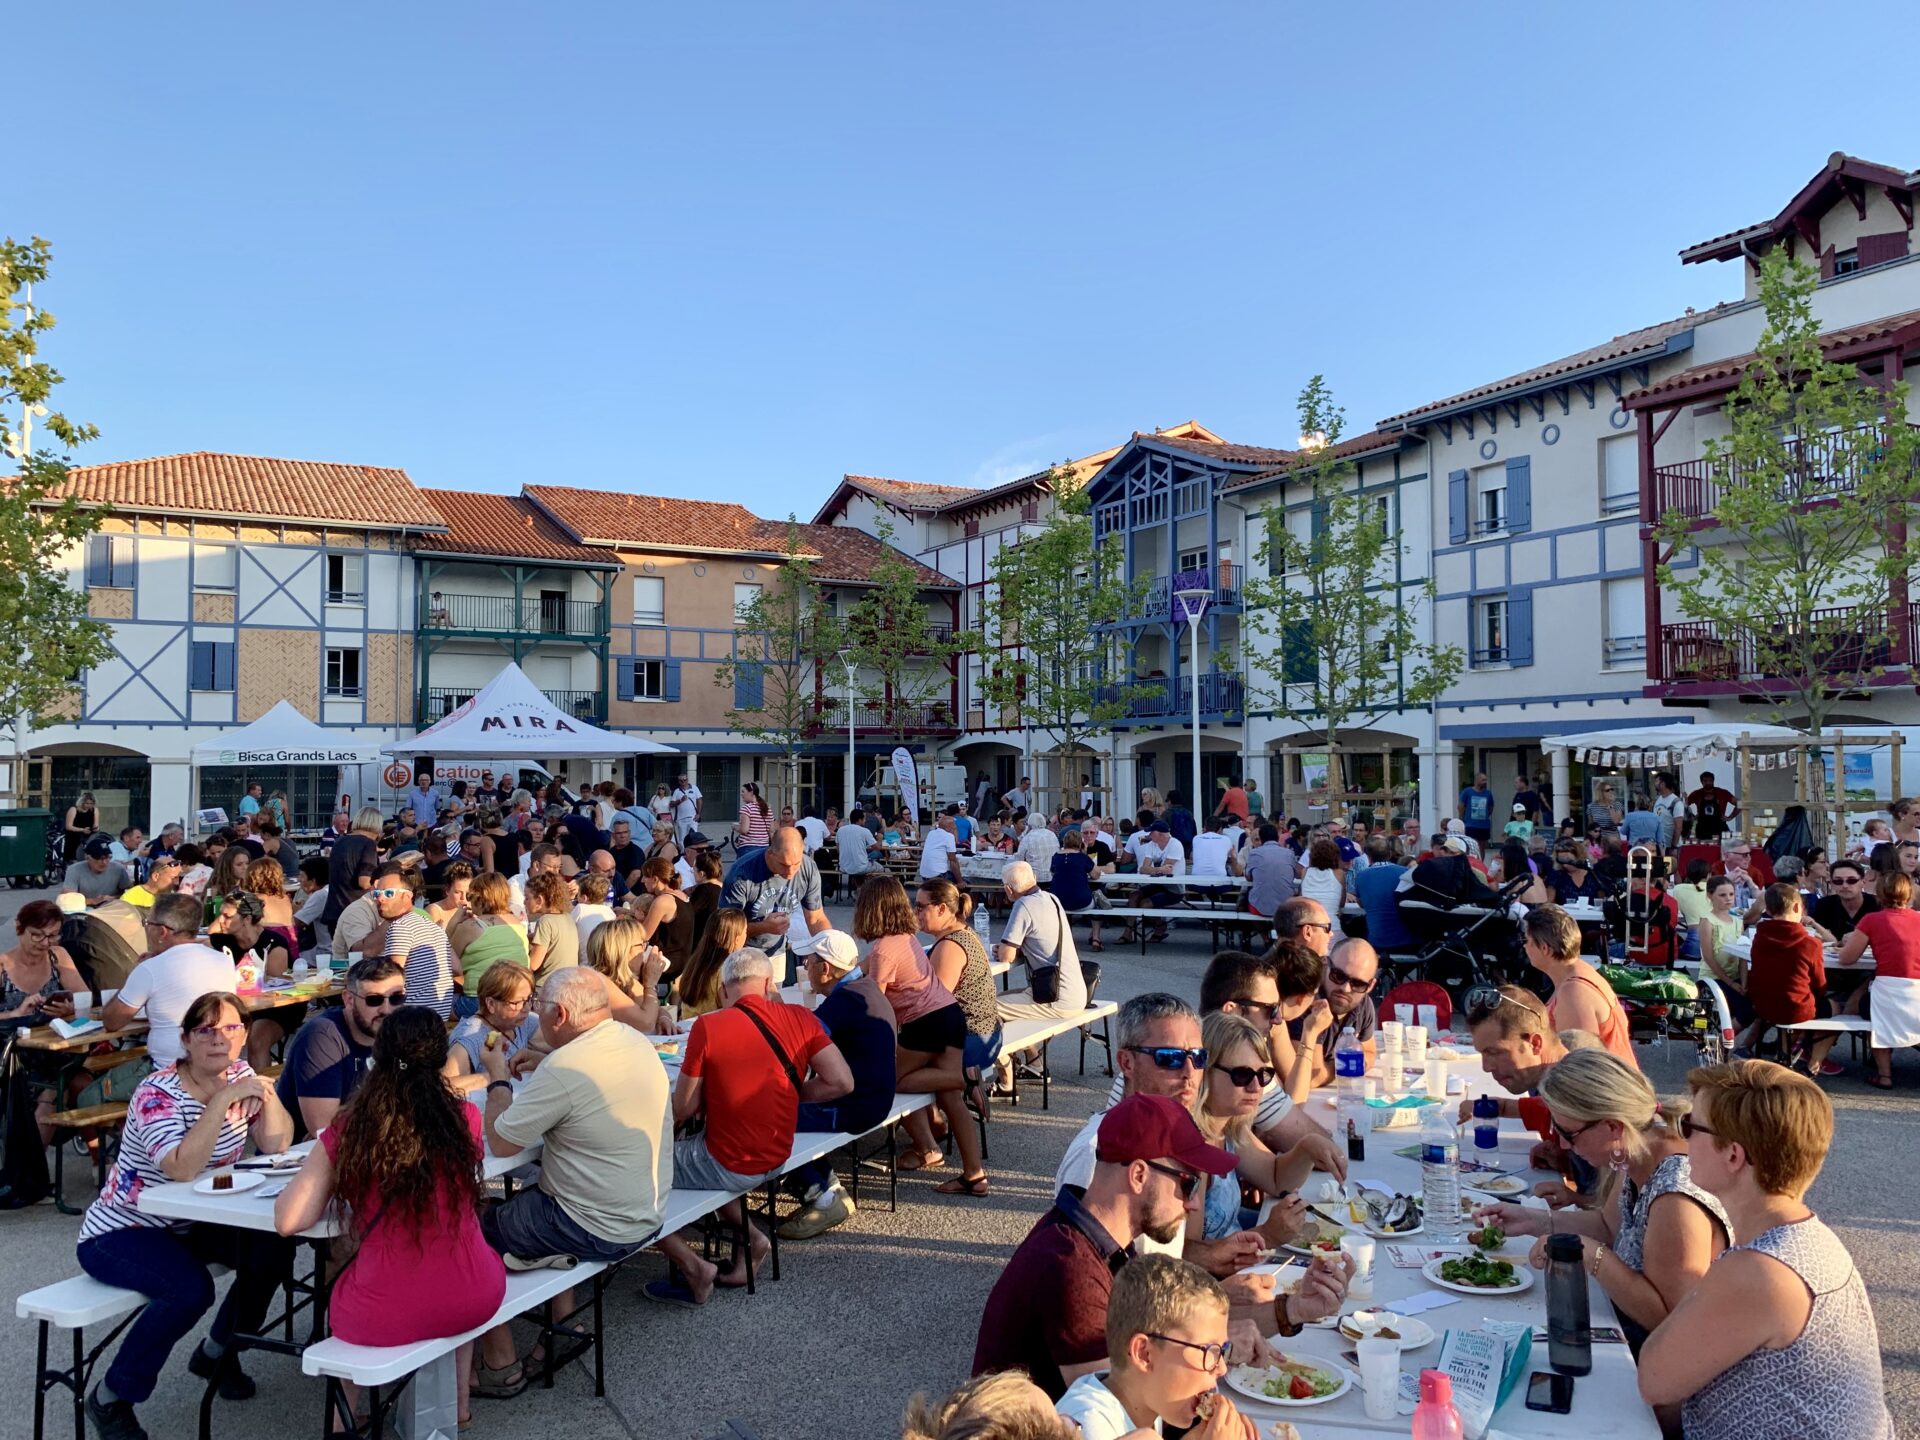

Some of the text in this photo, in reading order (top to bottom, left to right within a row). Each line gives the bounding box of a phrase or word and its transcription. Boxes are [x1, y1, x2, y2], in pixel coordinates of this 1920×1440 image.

[480, 715, 577, 734] MIRA
[238, 750, 357, 762] Bisca Grands Lacs
[435, 764, 492, 779] cation
[1448, 1363, 1488, 1380] MOULIN
